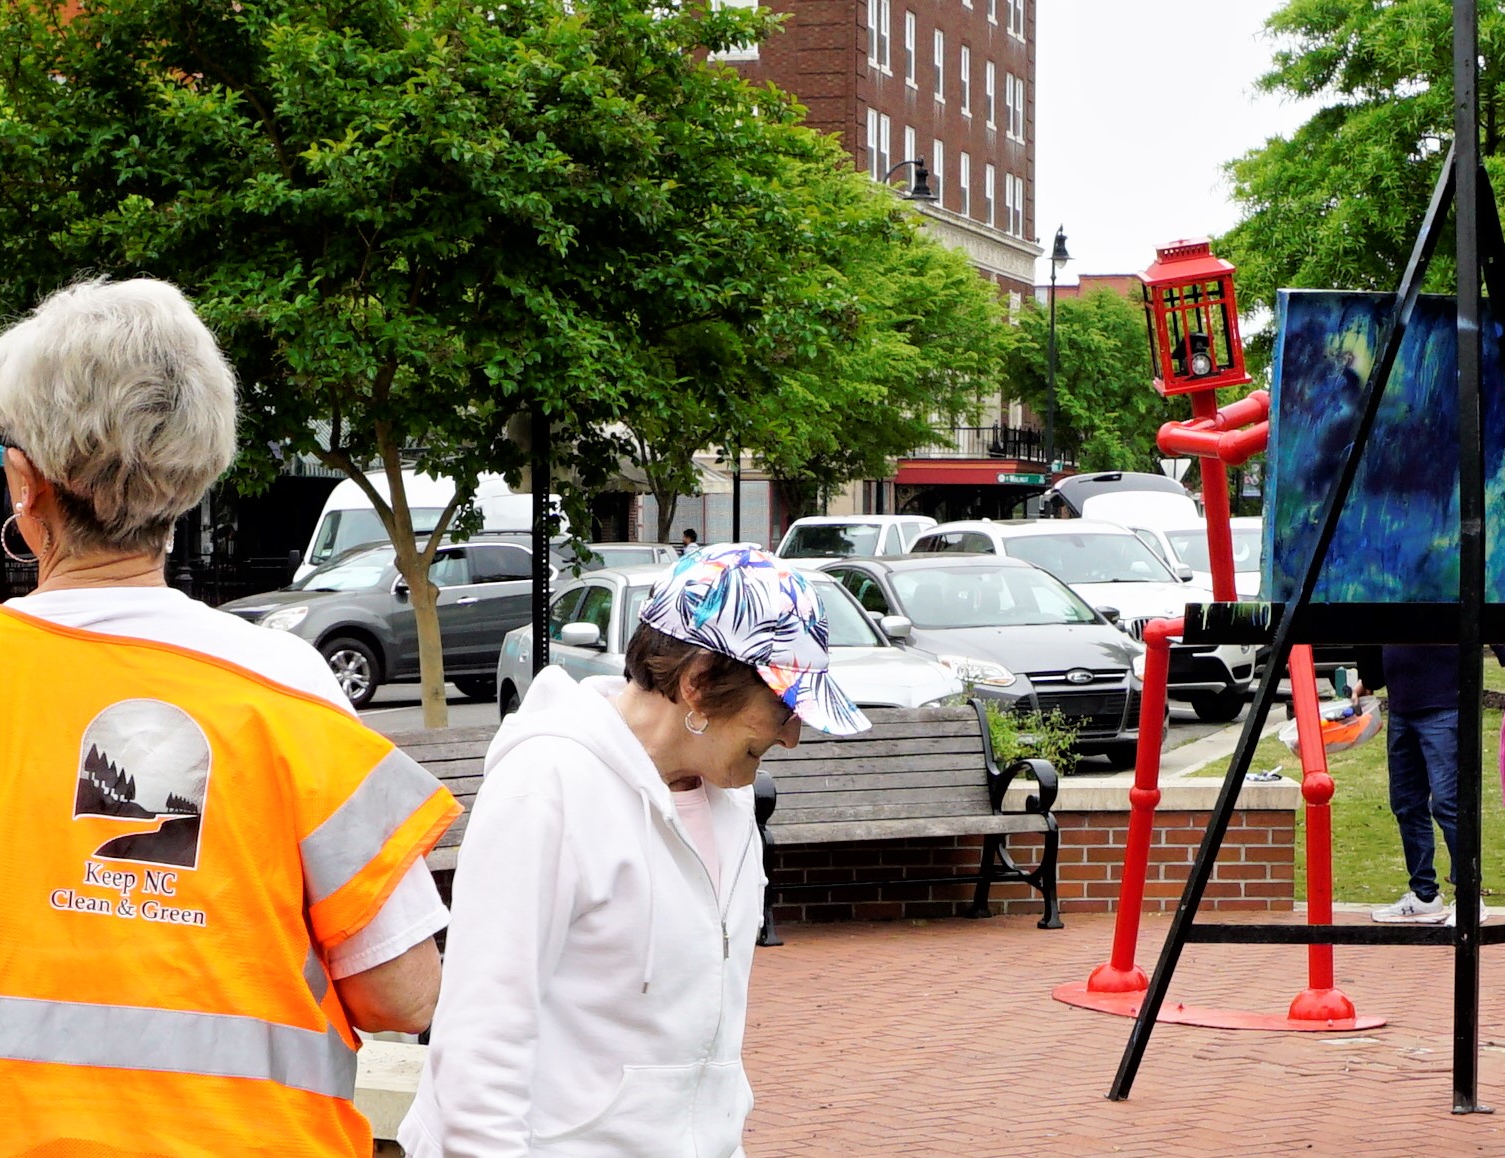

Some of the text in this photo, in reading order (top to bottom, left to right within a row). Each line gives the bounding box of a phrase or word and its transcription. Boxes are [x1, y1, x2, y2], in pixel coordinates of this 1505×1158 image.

[84, 861, 176, 895] Keep NC
[50, 889, 205, 925] Clean & Green
